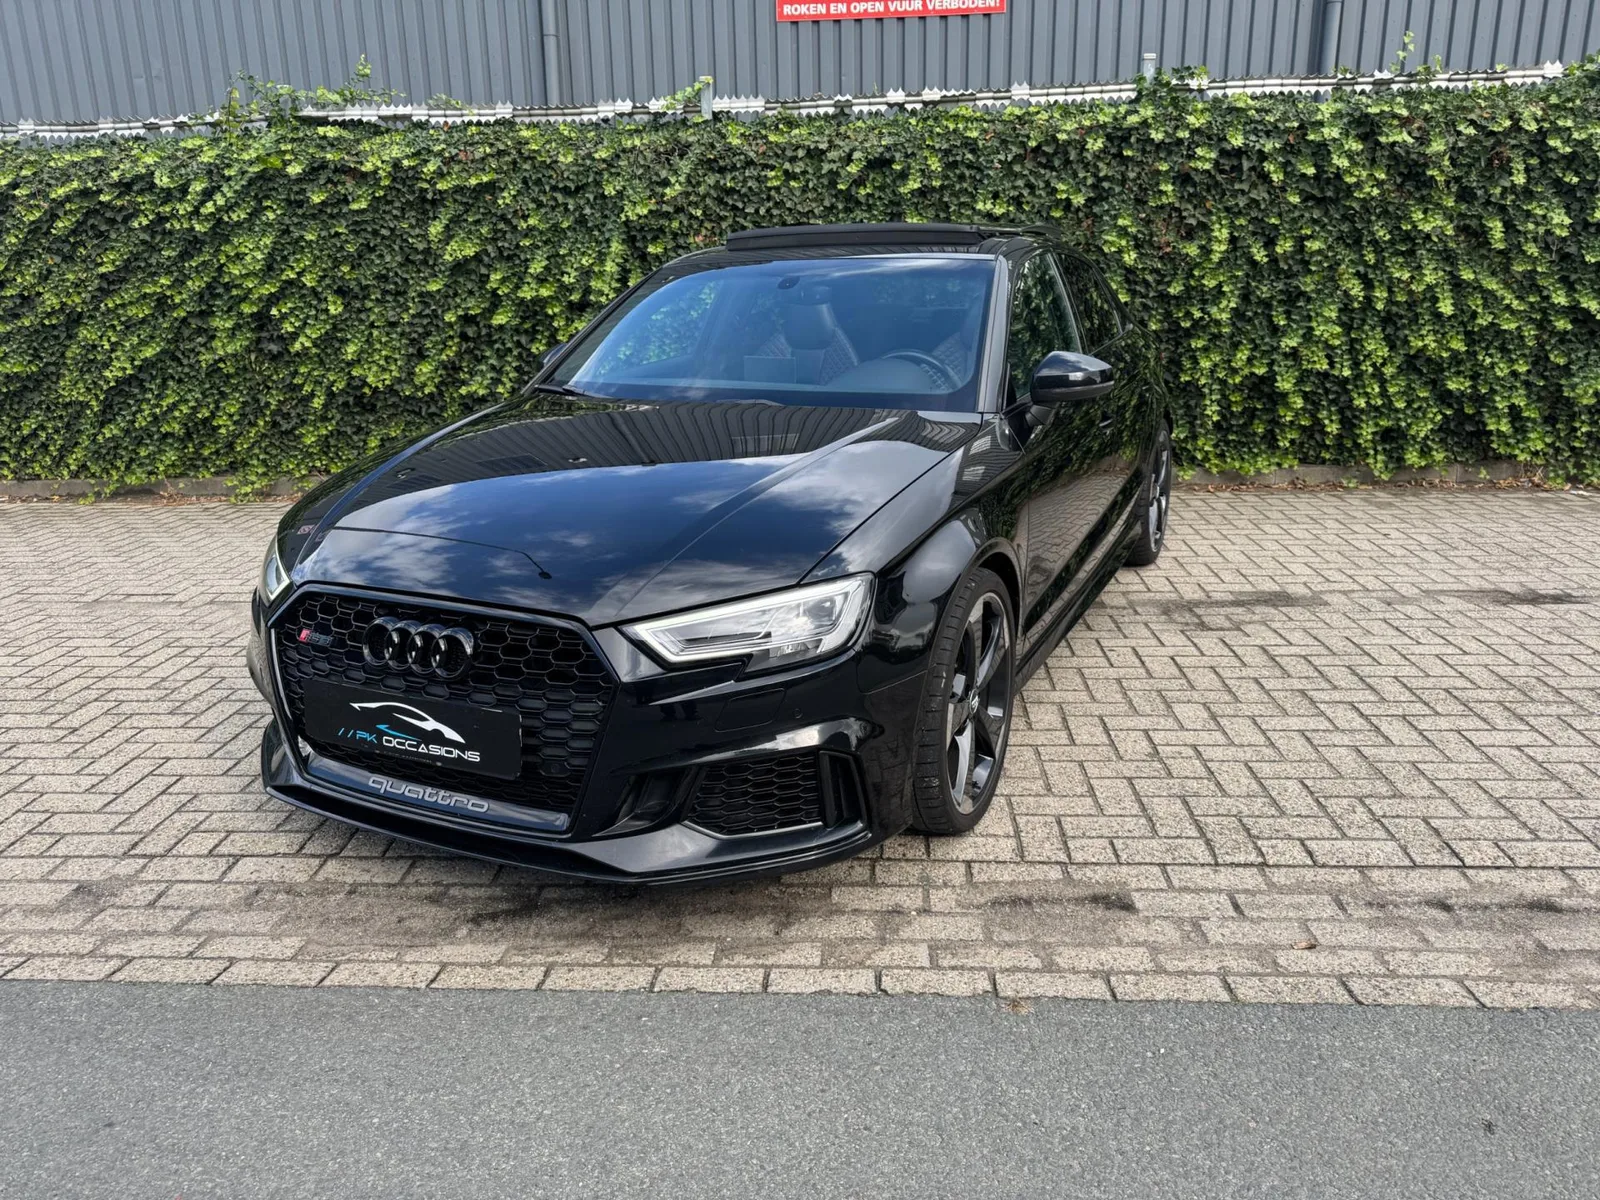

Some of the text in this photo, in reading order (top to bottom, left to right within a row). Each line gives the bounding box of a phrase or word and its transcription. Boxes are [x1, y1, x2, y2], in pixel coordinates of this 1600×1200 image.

[783, 4, 826, 16] ROKEN
[829, 3, 847, 14] EN
[850, 2, 885, 13] OPEN
[888, 0, 923, 12] VUUR
[382, 736, 481, 763] OCCASIONS
[368, 776, 490, 813] quattro
